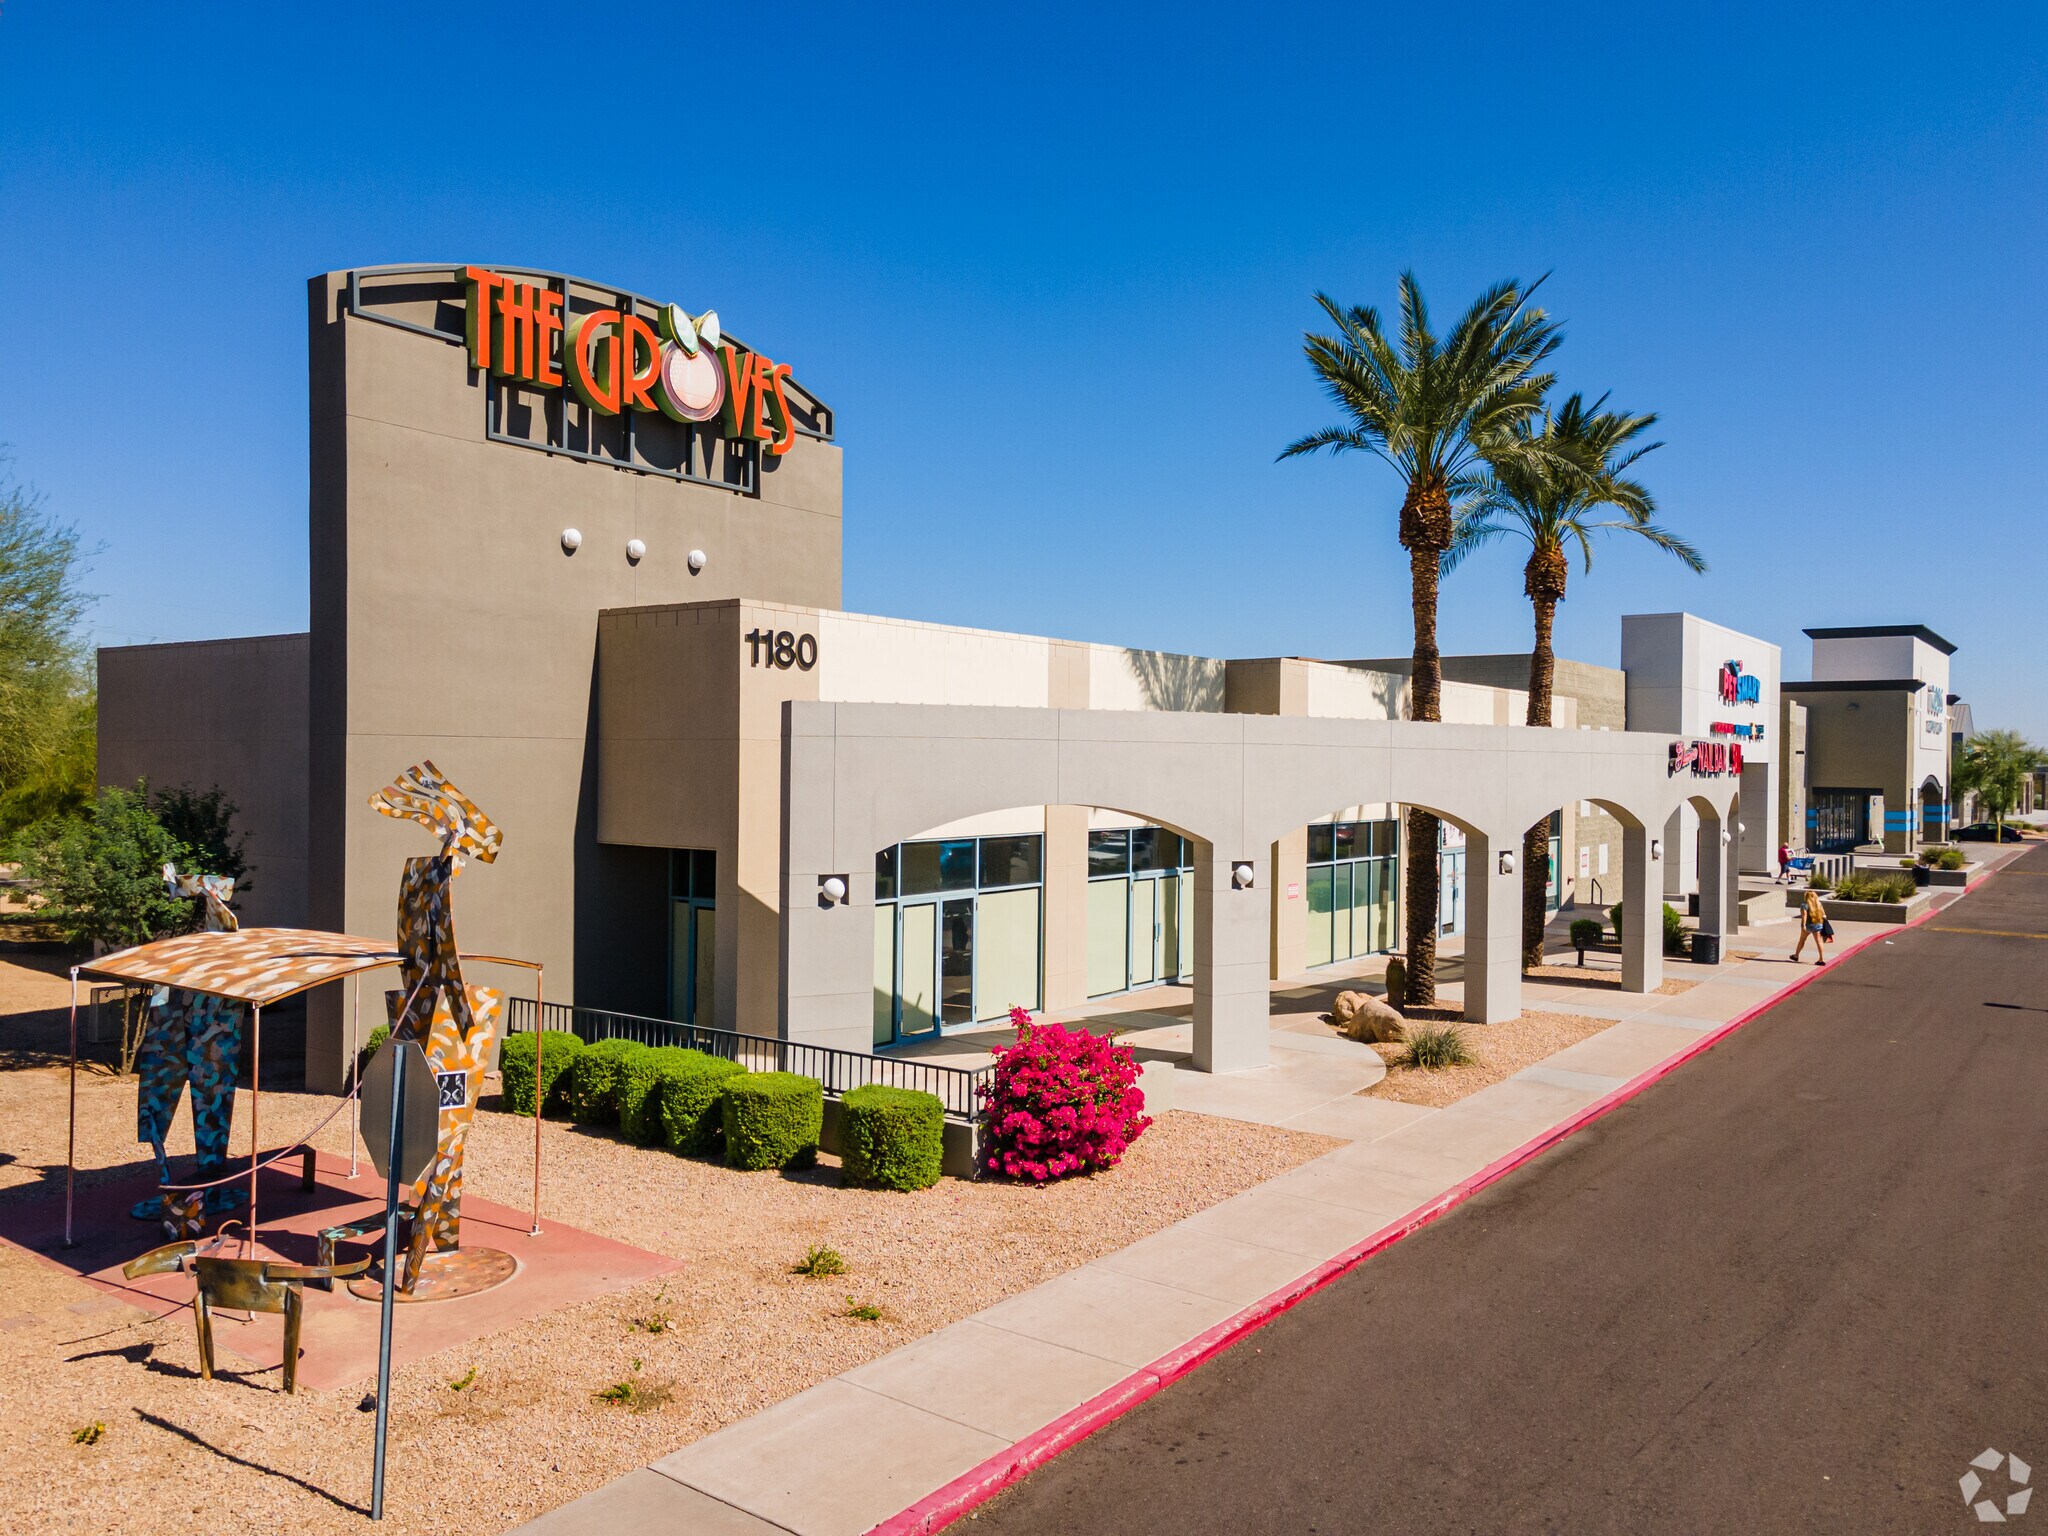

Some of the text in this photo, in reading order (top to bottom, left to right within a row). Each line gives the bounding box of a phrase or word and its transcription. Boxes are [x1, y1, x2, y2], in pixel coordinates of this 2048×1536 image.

[465, 265, 794, 457] THE GROVES
[745, 628, 818, 671] 1180
